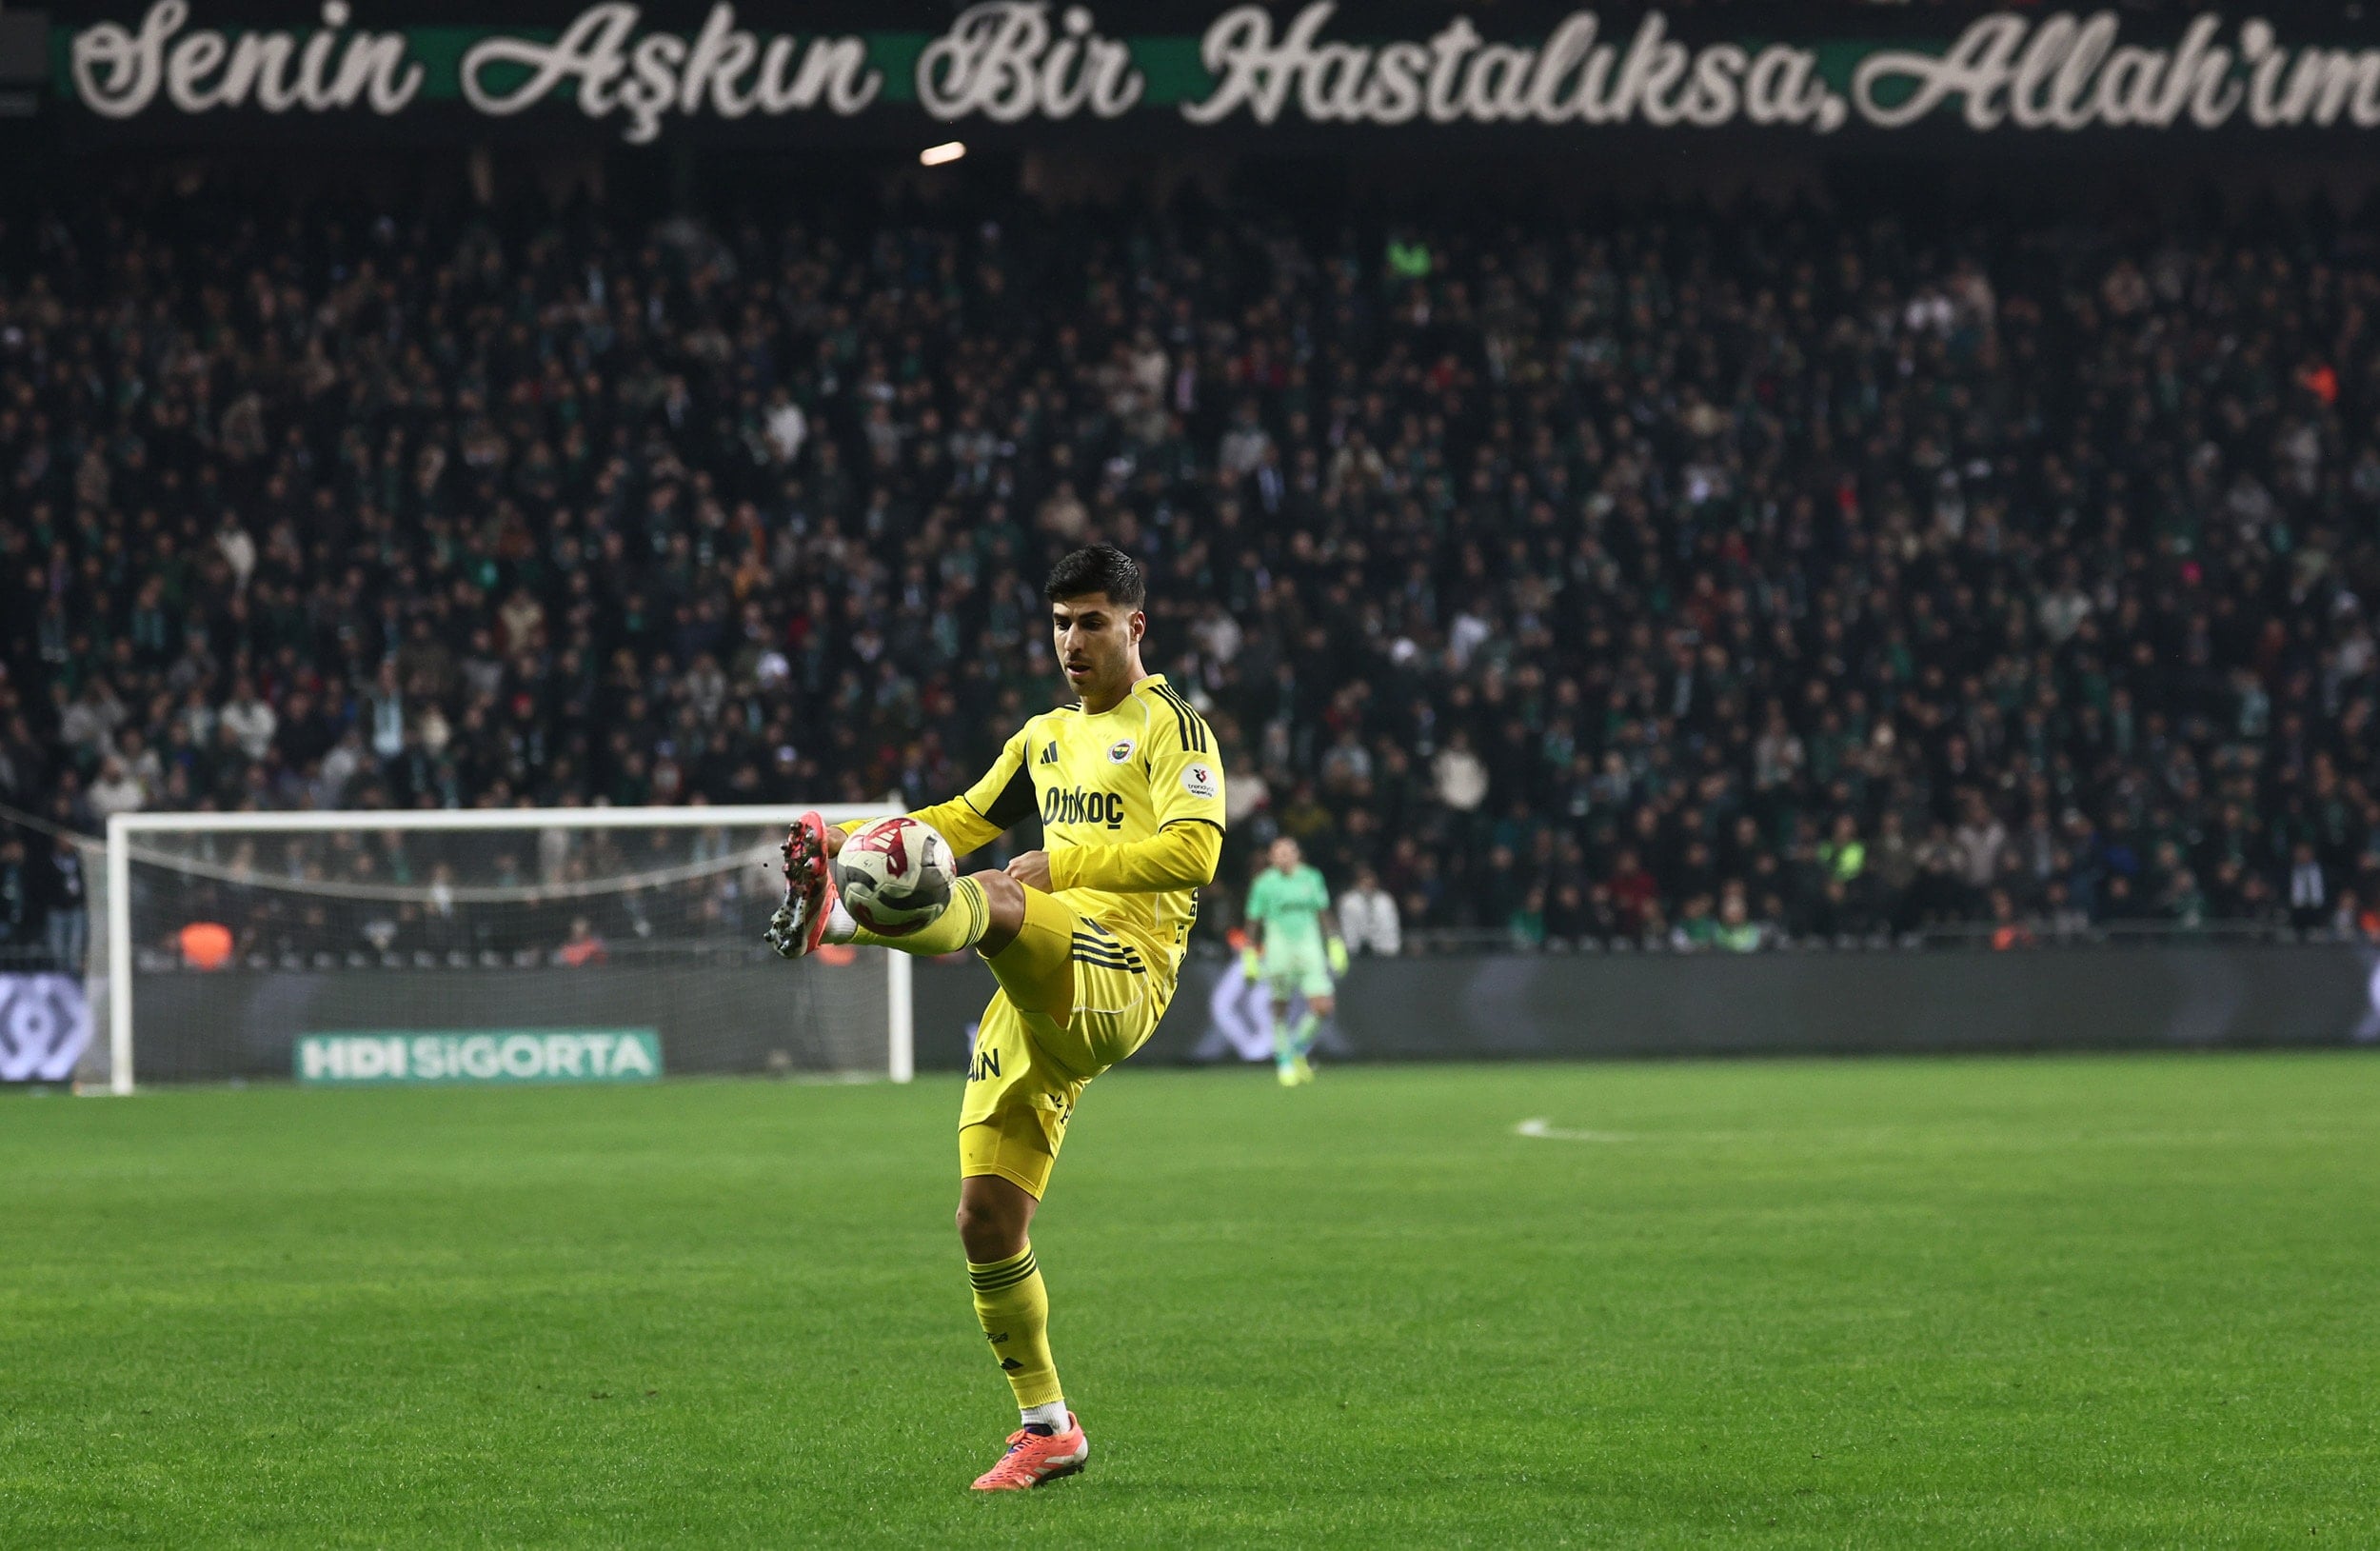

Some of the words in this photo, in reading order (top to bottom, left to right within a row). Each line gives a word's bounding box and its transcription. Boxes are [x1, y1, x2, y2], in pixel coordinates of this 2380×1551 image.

[71, 0, 425, 118] Senin
[460, 0, 883, 144] Aşkın
[915, 0, 1144, 122] Bir
[1179, 0, 1849, 133] Hastalıksa,
[303, 1037, 407, 1080] HDI
